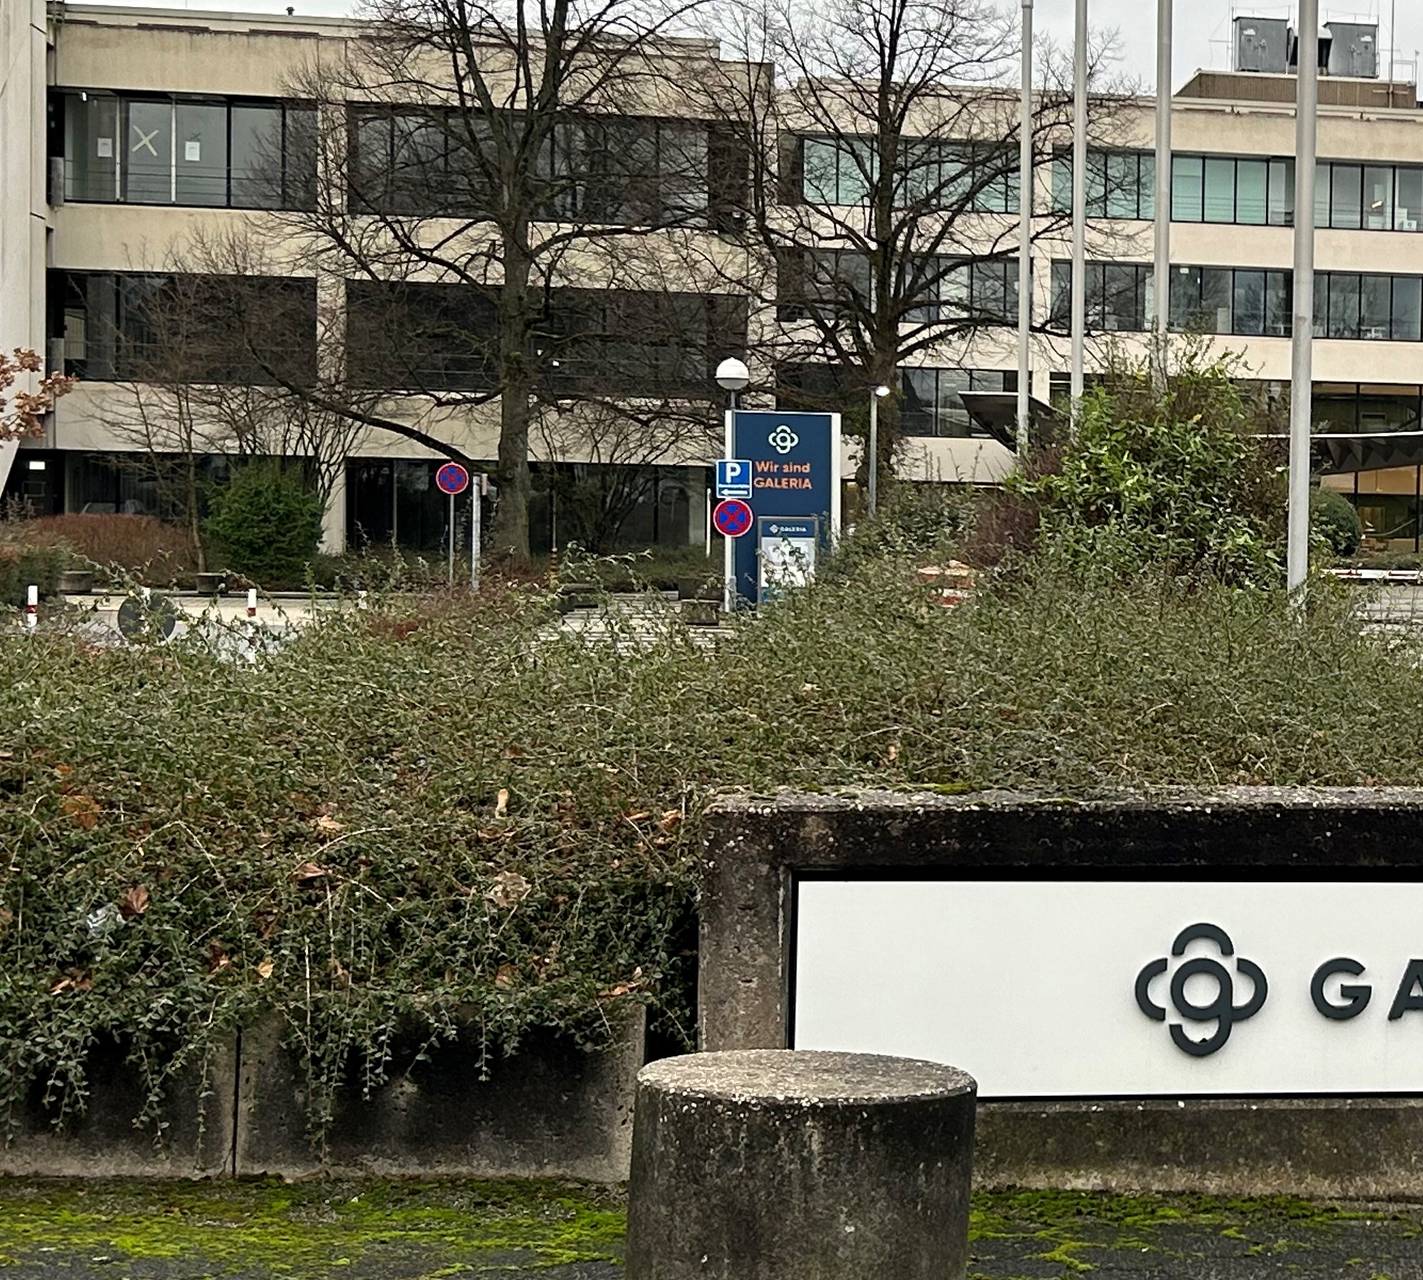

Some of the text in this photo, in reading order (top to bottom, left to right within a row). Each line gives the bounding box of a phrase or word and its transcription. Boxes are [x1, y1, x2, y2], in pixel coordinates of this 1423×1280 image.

[725, 462, 742, 484] P
[755, 460, 811, 473] Wir sind
[753, 477, 812, 489] GALERIA
